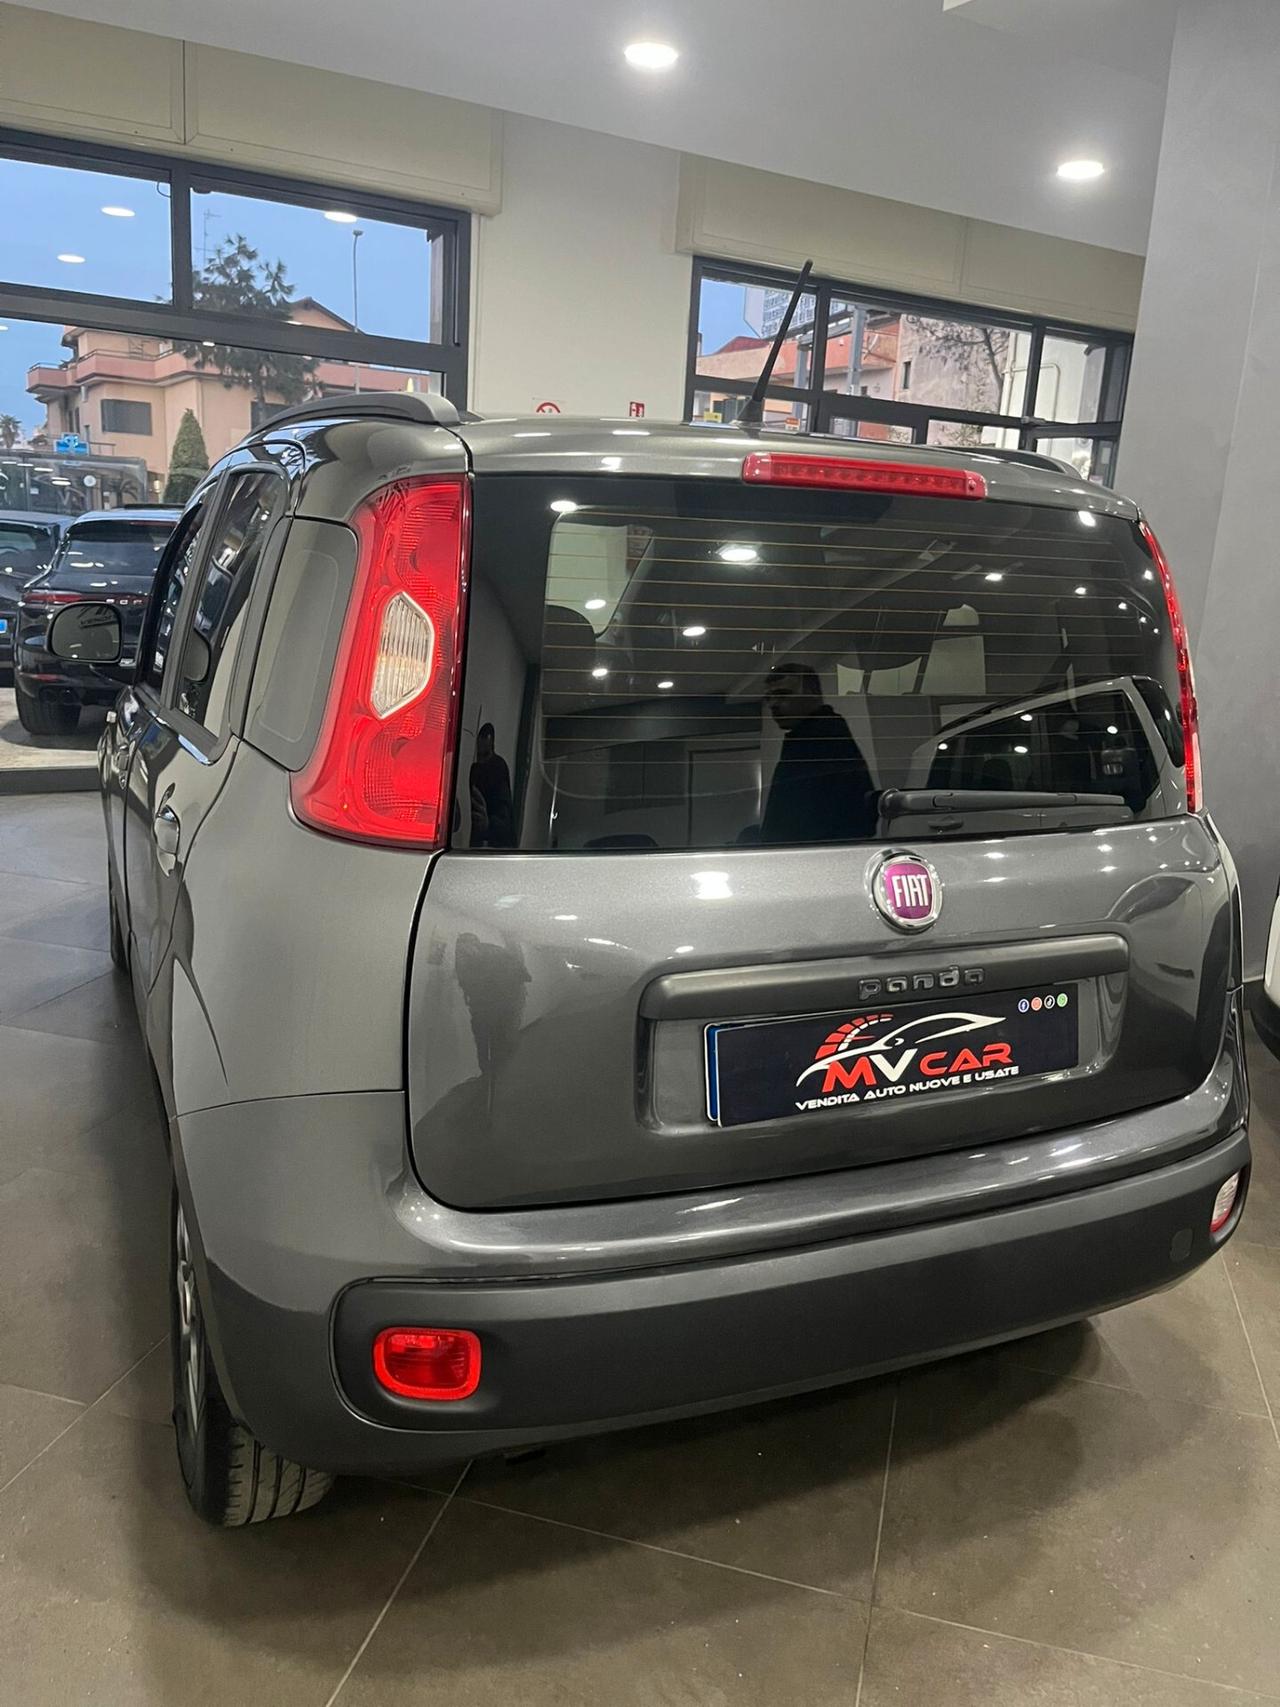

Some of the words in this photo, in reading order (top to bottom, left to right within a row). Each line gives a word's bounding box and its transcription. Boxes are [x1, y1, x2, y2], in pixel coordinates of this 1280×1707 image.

[891, 874, 929, 907] FIAT
[859, 965, 984, 1000] panda
[919, 1043, 1013, 1076] CAR
[795, 1093, 859, 1110] VENDITA
[864, 1084, 907, 1100] AUTO
[909, 1076, 960, 1092] NUOVE
[963, 1073, 972, 1083] E
[975, 1066, 1020, 1080] USATE
